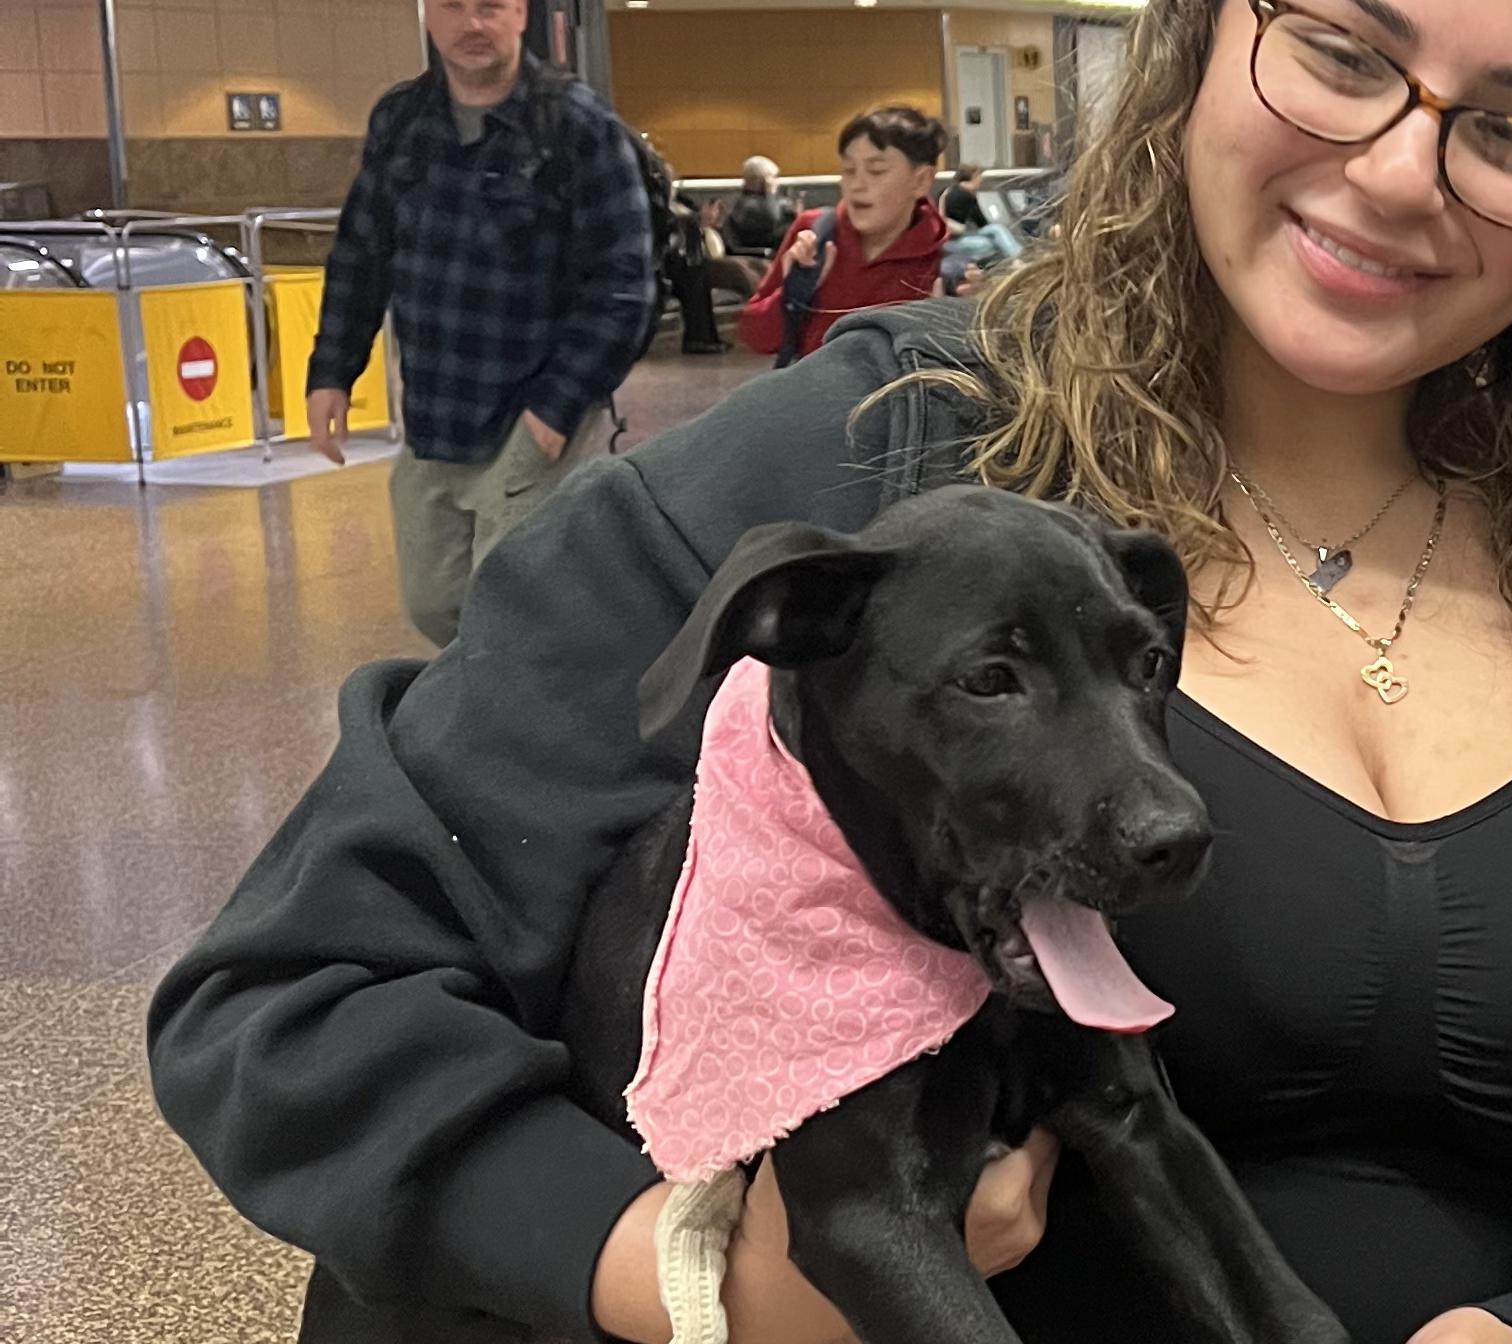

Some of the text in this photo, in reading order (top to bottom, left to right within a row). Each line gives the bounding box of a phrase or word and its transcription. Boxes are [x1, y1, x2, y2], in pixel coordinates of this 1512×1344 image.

[6, 360, 75, 376] DO NOT
[15, 377, 70, 393] ENTER
